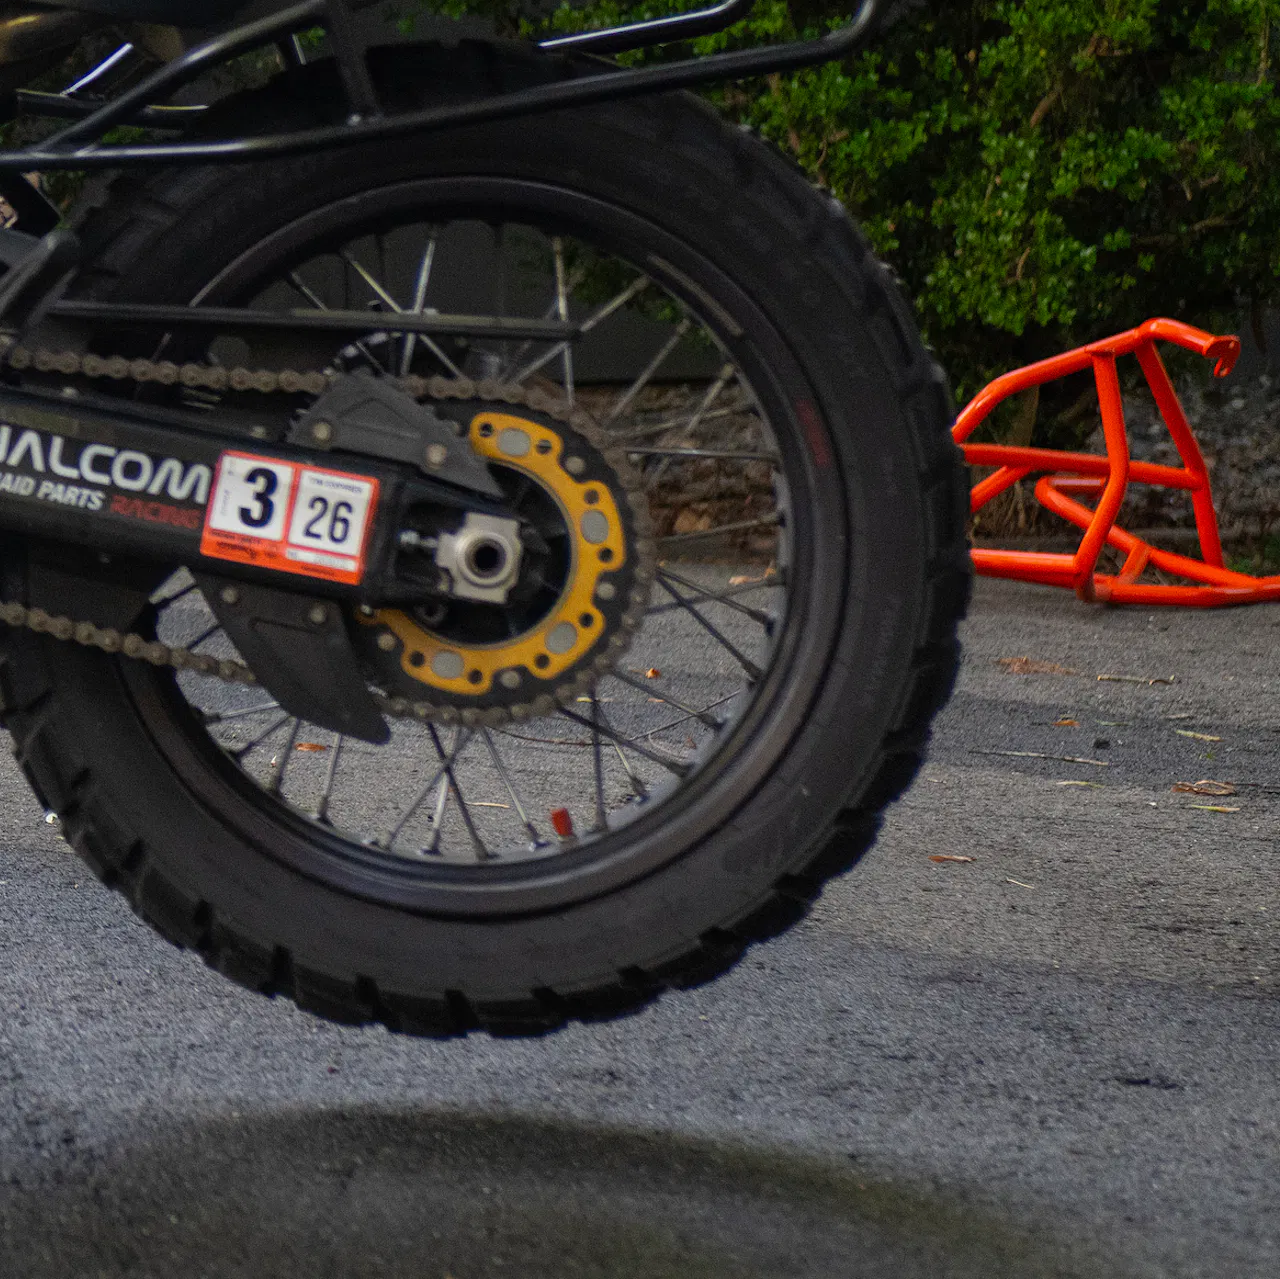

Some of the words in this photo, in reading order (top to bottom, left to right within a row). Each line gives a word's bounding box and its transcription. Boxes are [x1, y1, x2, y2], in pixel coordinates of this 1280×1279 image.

[37, 480, 107, 511] PARTS
[238, 466, 279, 528] 3
[302, 495, 353, 545] 26
